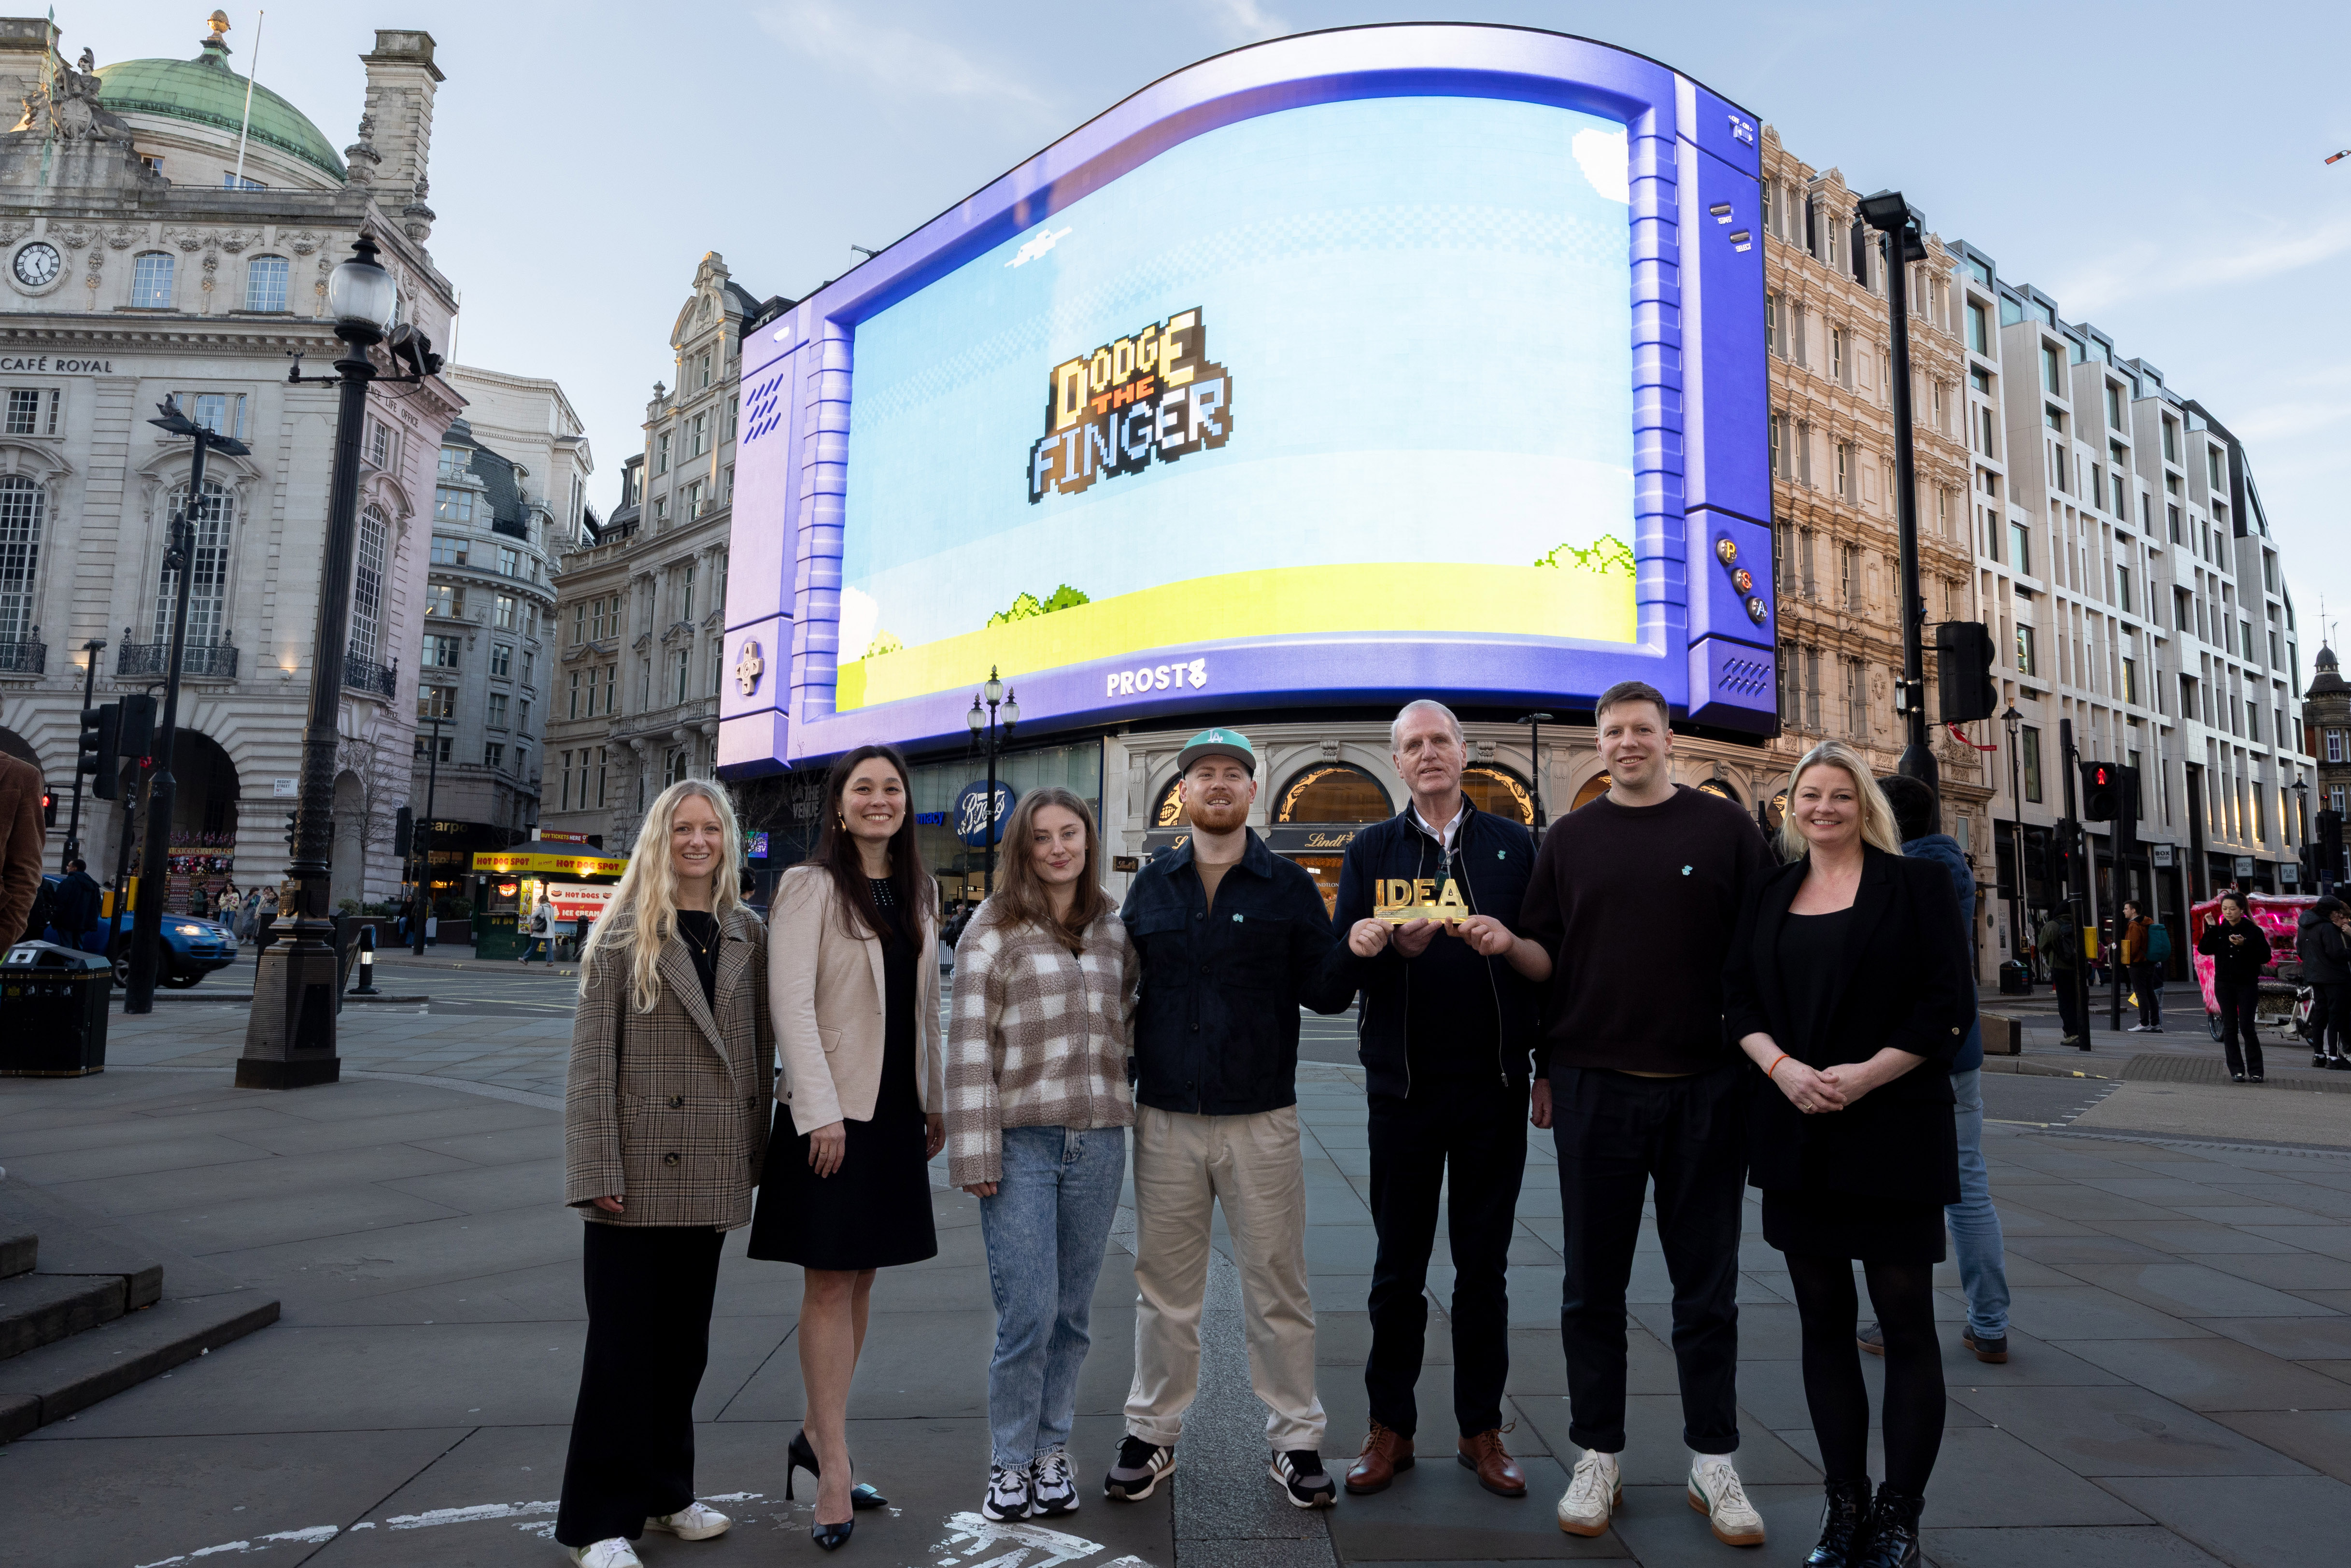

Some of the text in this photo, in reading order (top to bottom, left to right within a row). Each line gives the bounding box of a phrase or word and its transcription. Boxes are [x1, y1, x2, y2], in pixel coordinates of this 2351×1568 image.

[1718, 215, 1732, 225] START
[1735, 243, 1751, 253] SELECT
[1, 356, 113, 373] CAFÉ ROYAL
[1057, 311, 1195, 430] DODGE
[1091, 375, 1154, 415] THE
[385, 397, 397, 412] LIFE
[401, 409, 418, 428] OFFICE
[1034, 378, 1224, 494] FINGER
[1727, 542, 1735, 558] P
[1742, 572, 1751, 589] S
[1756, 600, 1766, 617] A
[72, 683, 151, 692] ALIANC
[194, 685, 230, 693] LIFE
[1207, 729, 1223, 743] LA
[916, 812, 943, 826] macy
[1304, 833, 1346, 847] Lindt
[556, 860, 619, 871] HOT DOG SPOT
[1375, 879, 1465, 906] IDEA
